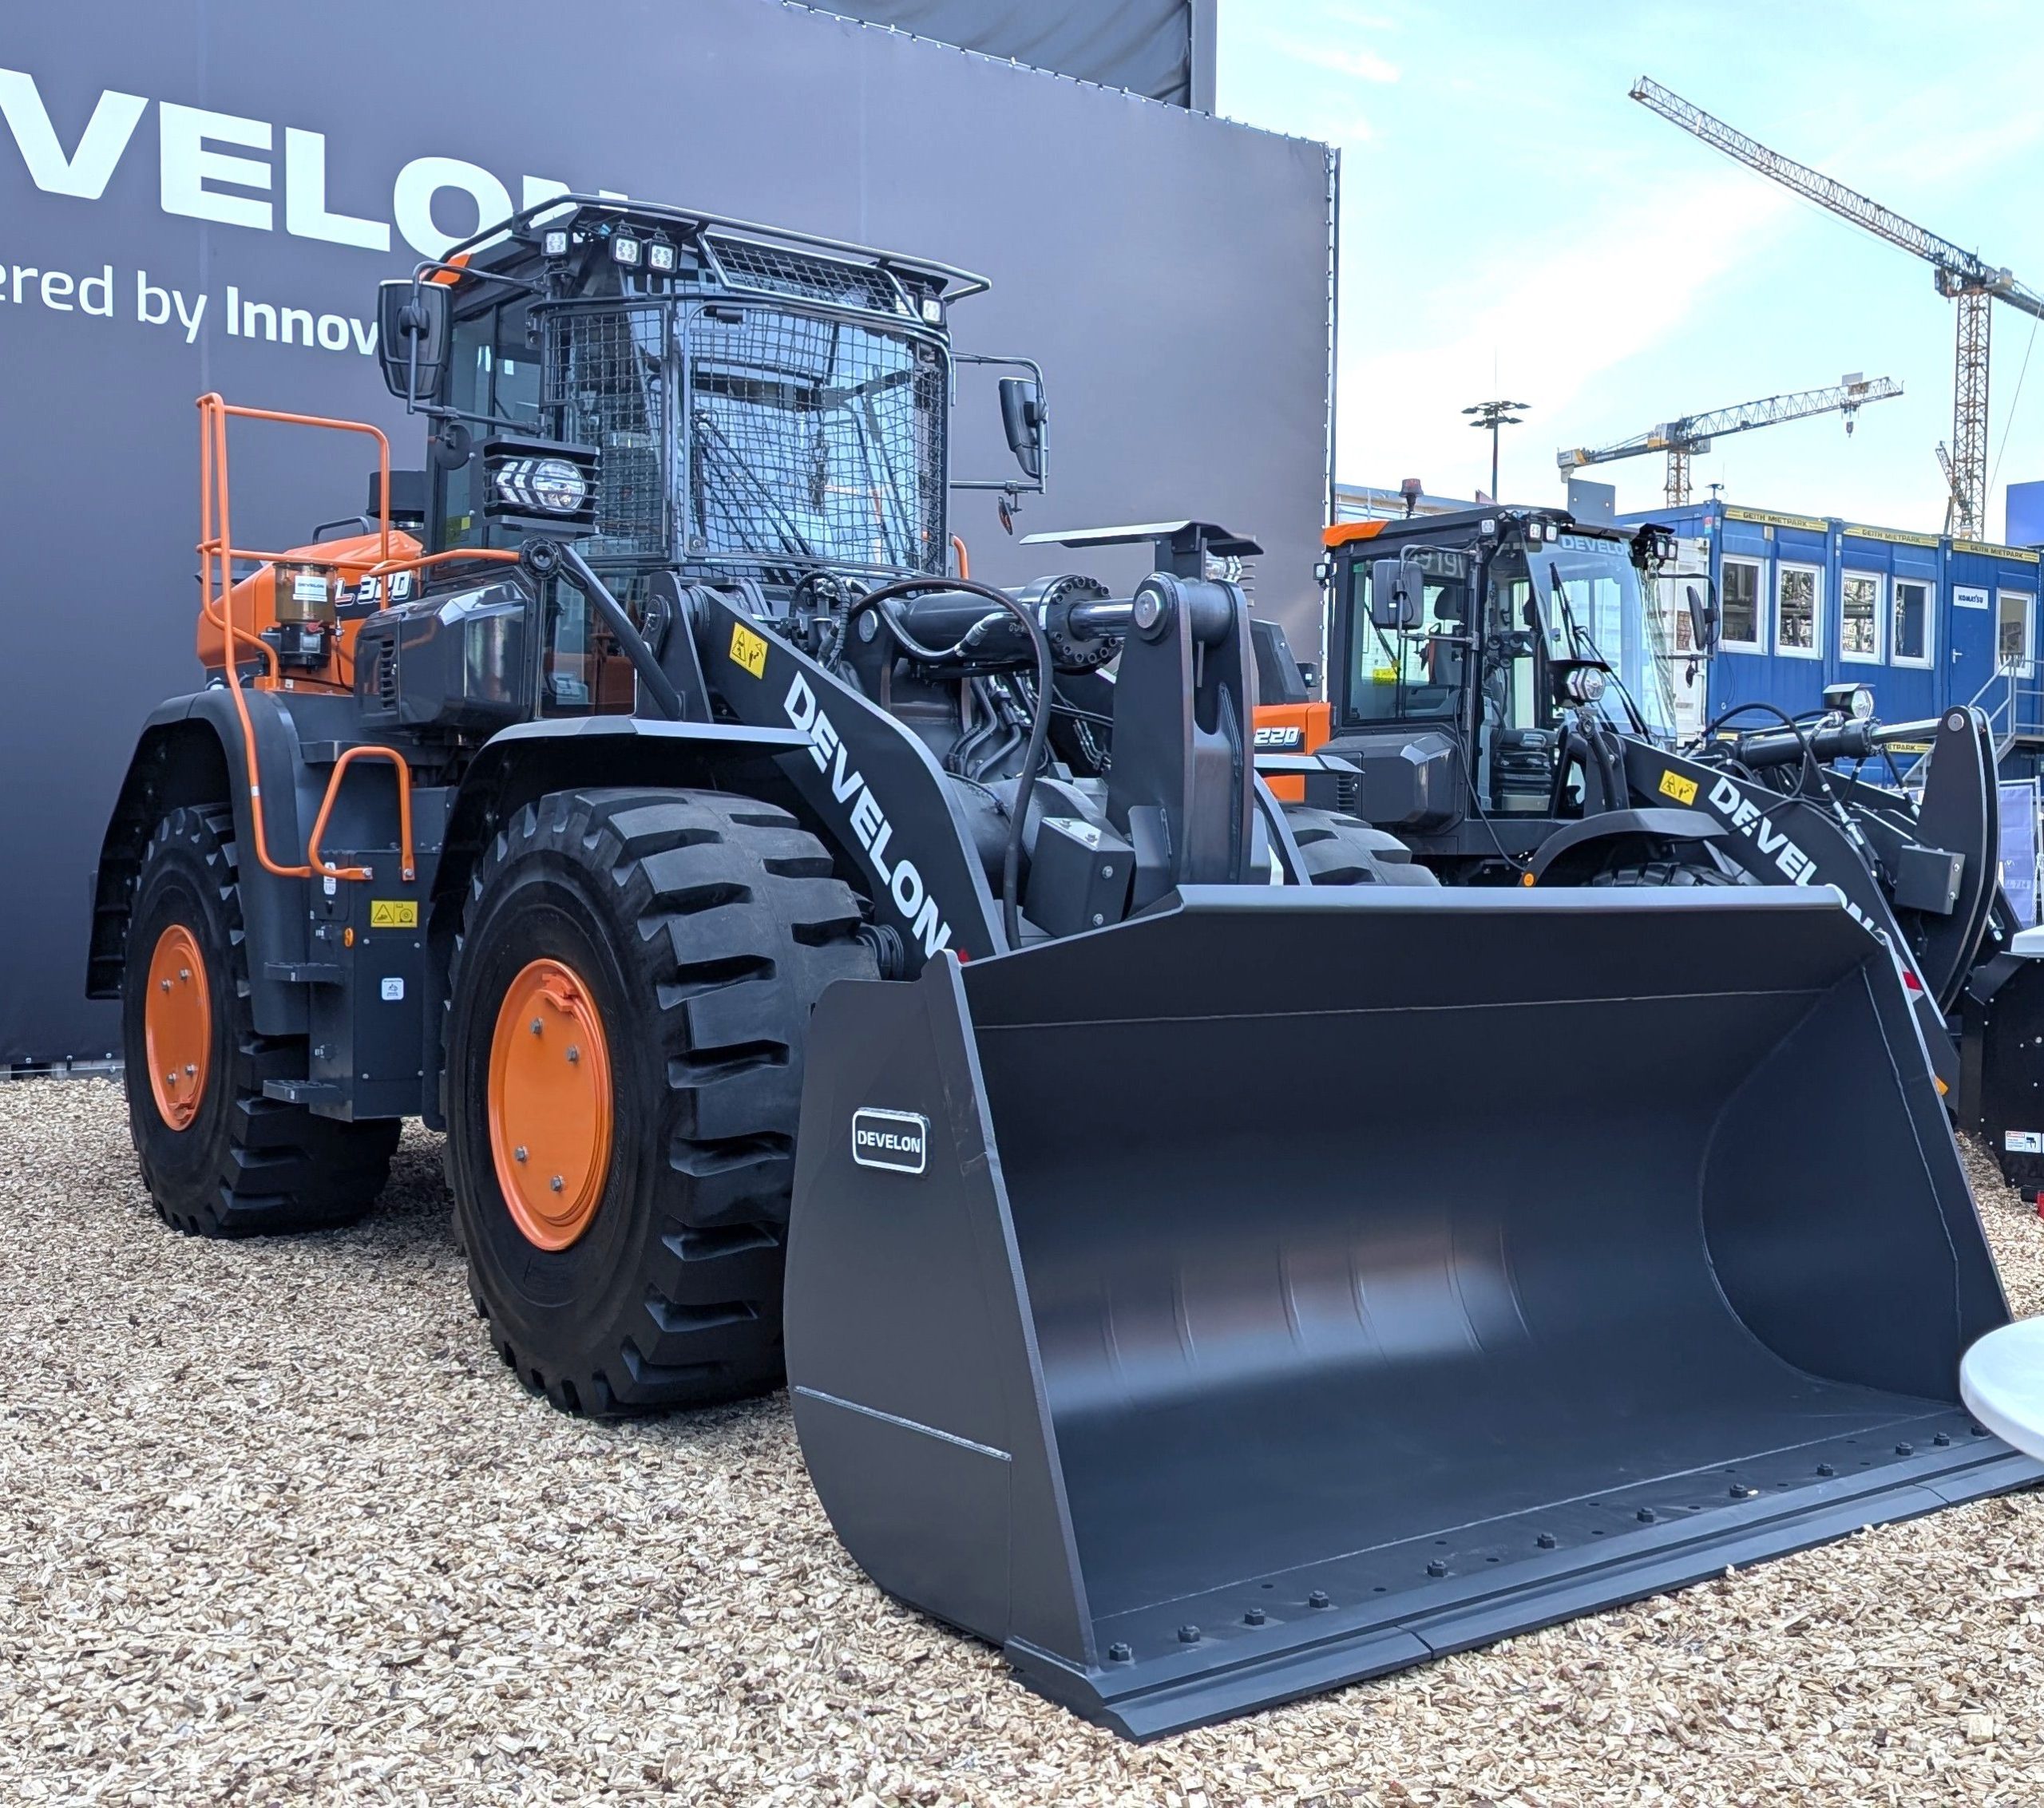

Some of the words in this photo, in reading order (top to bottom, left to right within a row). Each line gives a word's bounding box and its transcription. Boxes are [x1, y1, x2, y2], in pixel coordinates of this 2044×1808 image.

[0, 264, 113, 317] red
[137, 270, 208, 343] by
[1958, 594, 1983, 603] KOMATSU
[1254, 727, 1300, 746] 220
[784, 671, 952, 959] DEVELON
[858, 1130, 921, 1153] DEVELON
